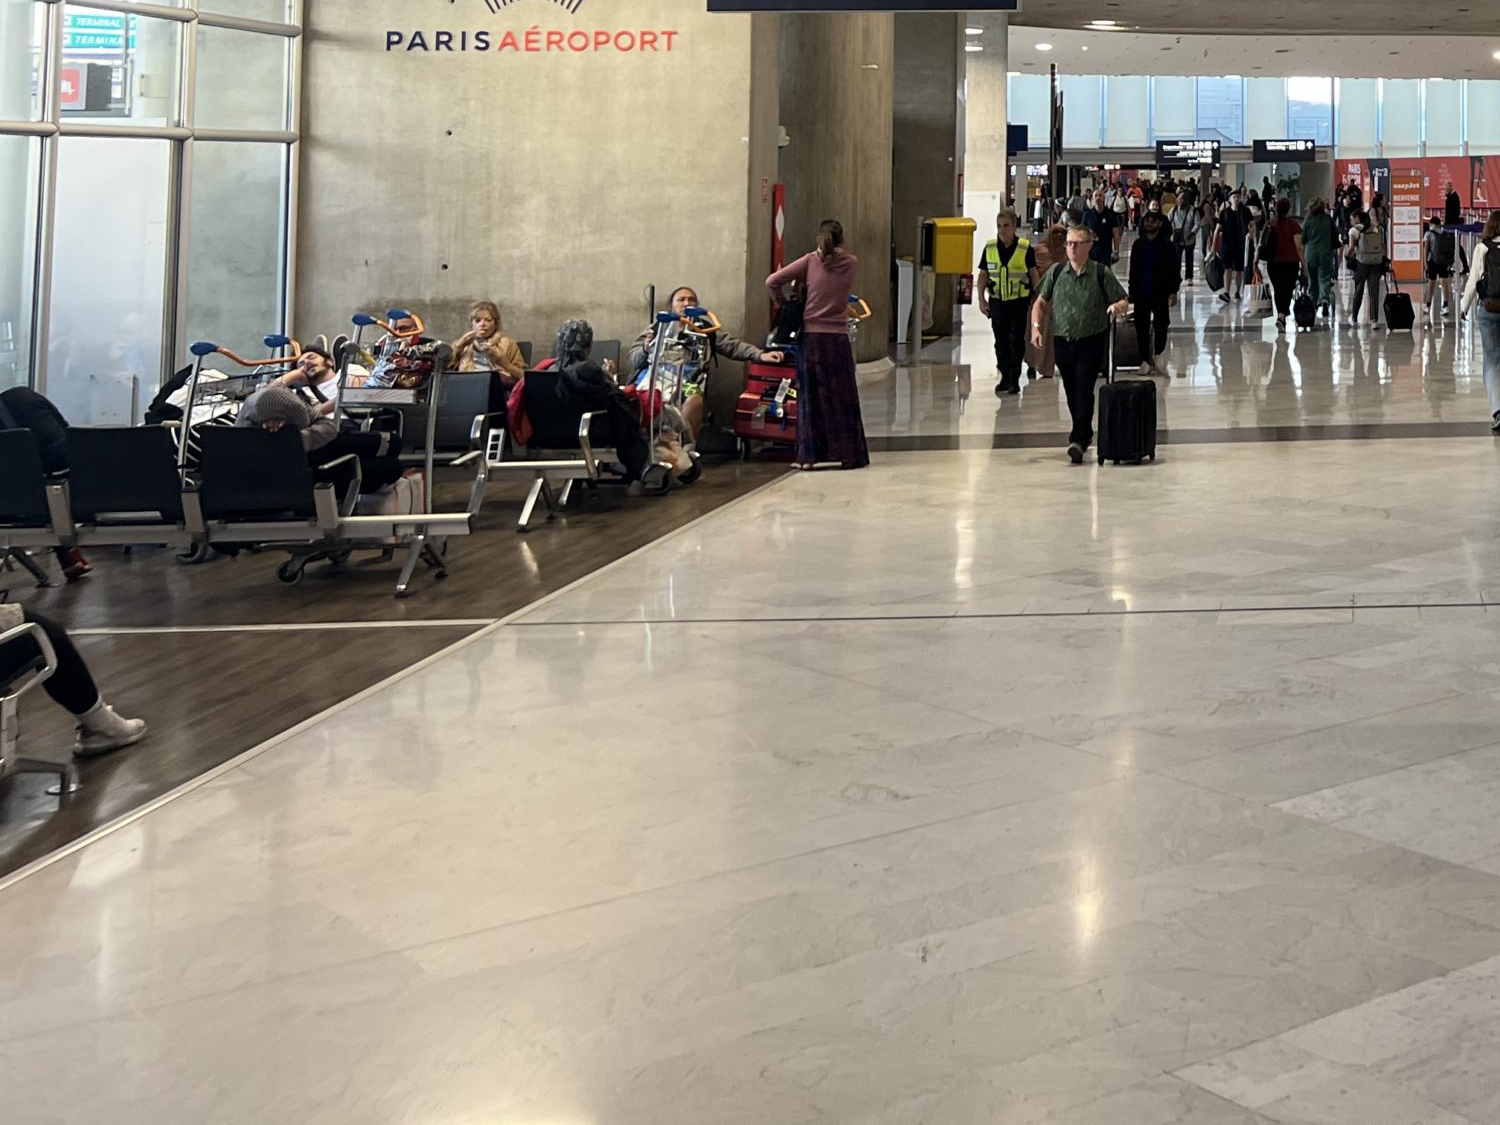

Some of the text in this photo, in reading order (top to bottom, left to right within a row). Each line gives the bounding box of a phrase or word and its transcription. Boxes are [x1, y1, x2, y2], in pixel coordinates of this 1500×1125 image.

[75, 17, 121, 27] TERMINAL
[75, 35, 124, 44] TERMINA
[385, 25, 679, 52] PARIS AÉROPORT
